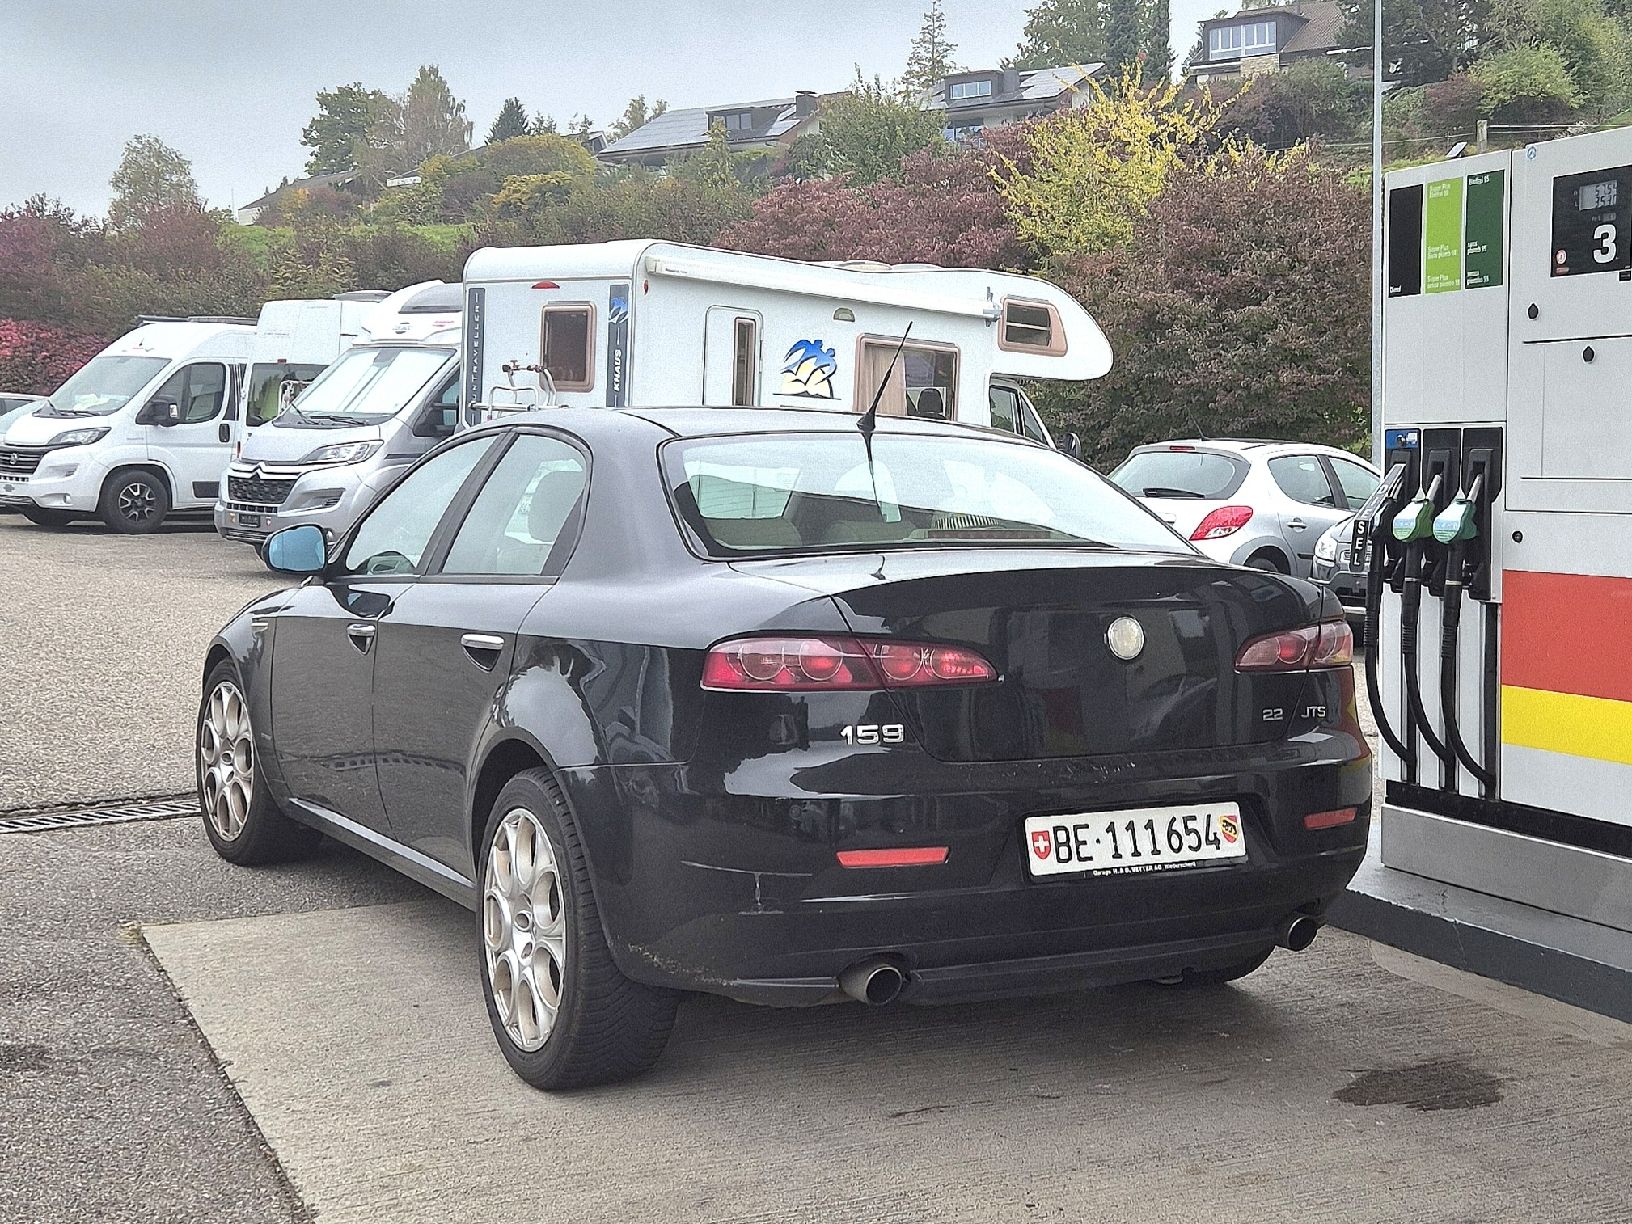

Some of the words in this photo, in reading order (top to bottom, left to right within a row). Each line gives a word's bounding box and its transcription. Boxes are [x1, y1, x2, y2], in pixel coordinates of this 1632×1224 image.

[1593, 224, 1617, 263] 3
[470, 305, 480, 407] UNTRAVELLER
[613, 349, 622, 392] KNAUS
[1300, 706, 1326, 718] JTS
[840, 723, 904, 745] 159
